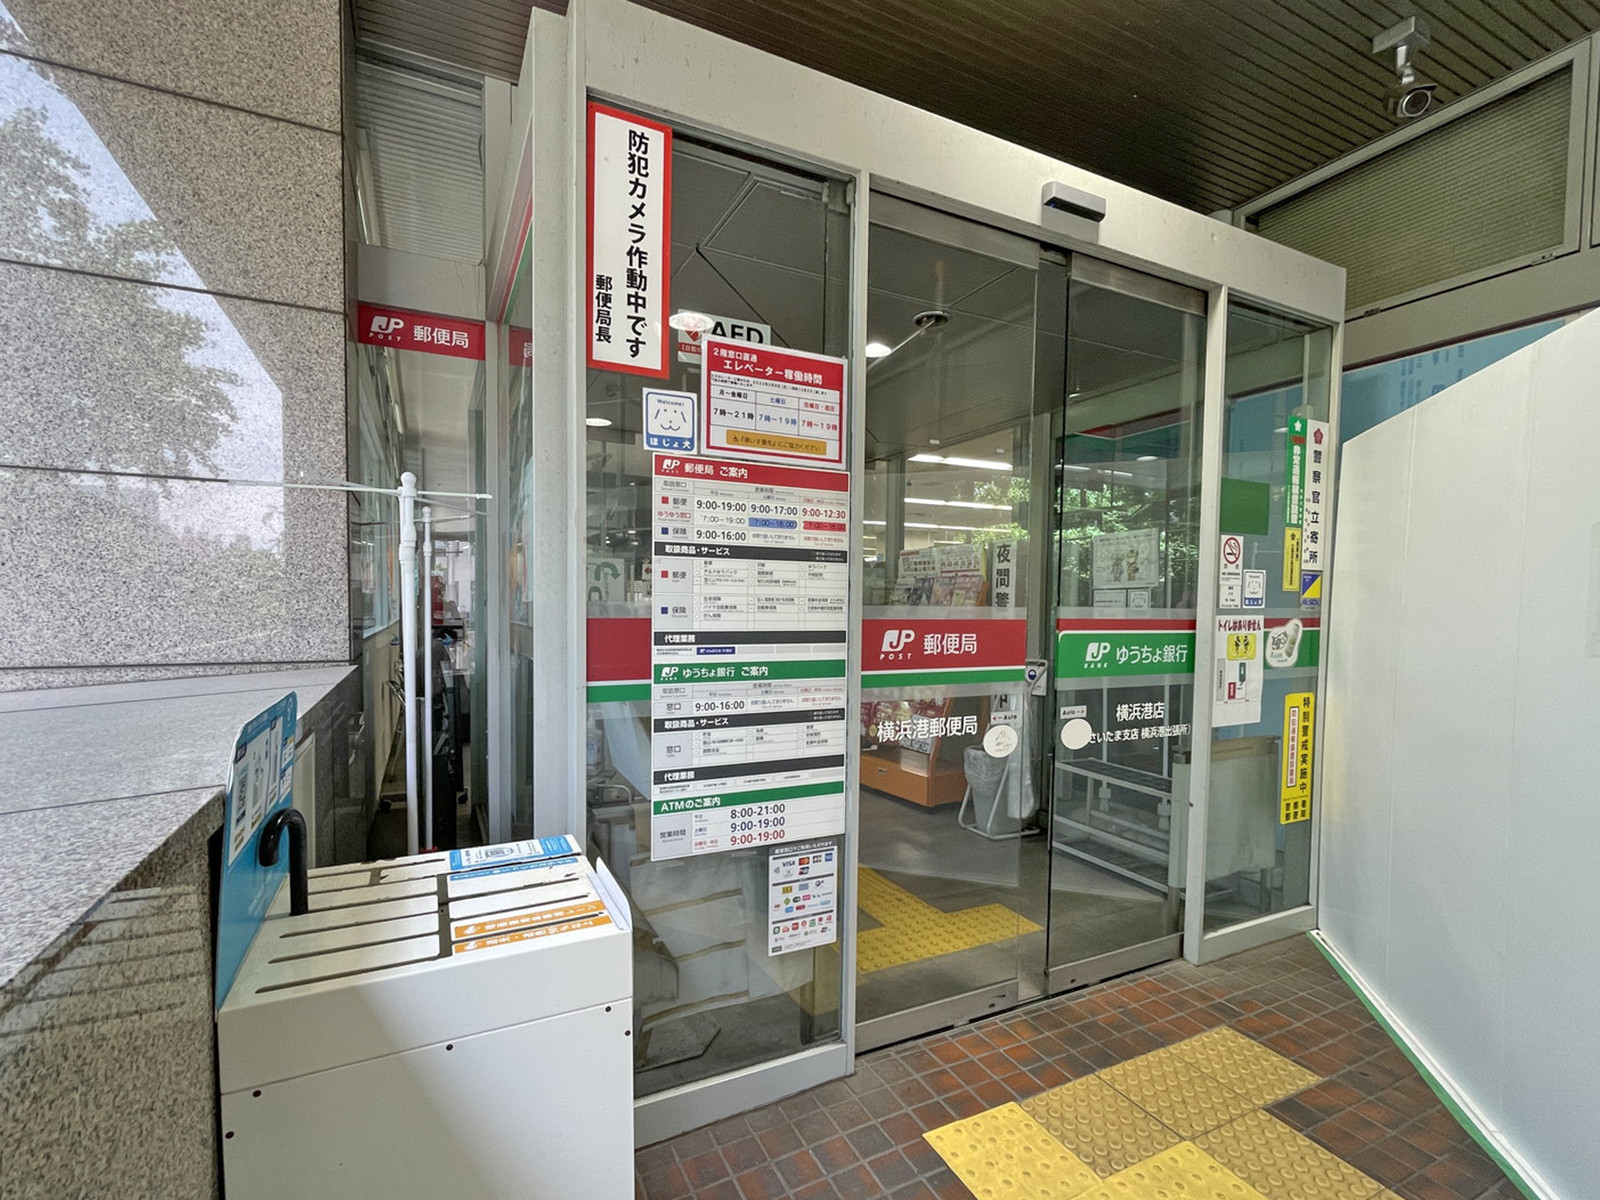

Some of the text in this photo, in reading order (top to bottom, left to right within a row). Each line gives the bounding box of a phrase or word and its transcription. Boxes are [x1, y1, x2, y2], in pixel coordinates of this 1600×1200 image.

[627, 129, 650, 358] 防犯カメラ作動中です
[595, 274, 612, 344] 郵便局長
[368, 333, 402, 342] POST
[413, 325, 469, 349] 郵便局
[723, 359, 823, 386] エレベーター稼働時間
[650, 437, 691, 449] ほじょ犬
[684, 463, 748, 479] 郵便局 ご案内
[696, 499, 846, 519] 9:00-19:00 9:00-17:00 9:00-12:30
[1309, 449, 1323, 564] 警察官立寄所
[696, 529, 747, 541] 9:00-16:00
[665, 545, 730, 555] 取扱商品・サービス
[1218, 619, 1261, 632] トイレはありません
[923, 633, 977, 655] 郵便局
[1116, 644, 1188, 664] ゆうちょ銀行
[682, 665, 768, 679] ゆうちょ銀行 ご案内
[695, 700, 745, 712] 9:00-16:00
[1116, 701, 1165, 722] 横浜港店
[664, 717, 729, 729] 取扱商品・サービス
[877, 715, 978, 743] 横浜港郵便局
[660, 796, 720, 812] ATMのご案内
[730, 803, 786, 820] 8:00-21:00
[730, 816, 786, 833] 9:00-19:00
[730, 829, 786, 846] 9:00-19:00
